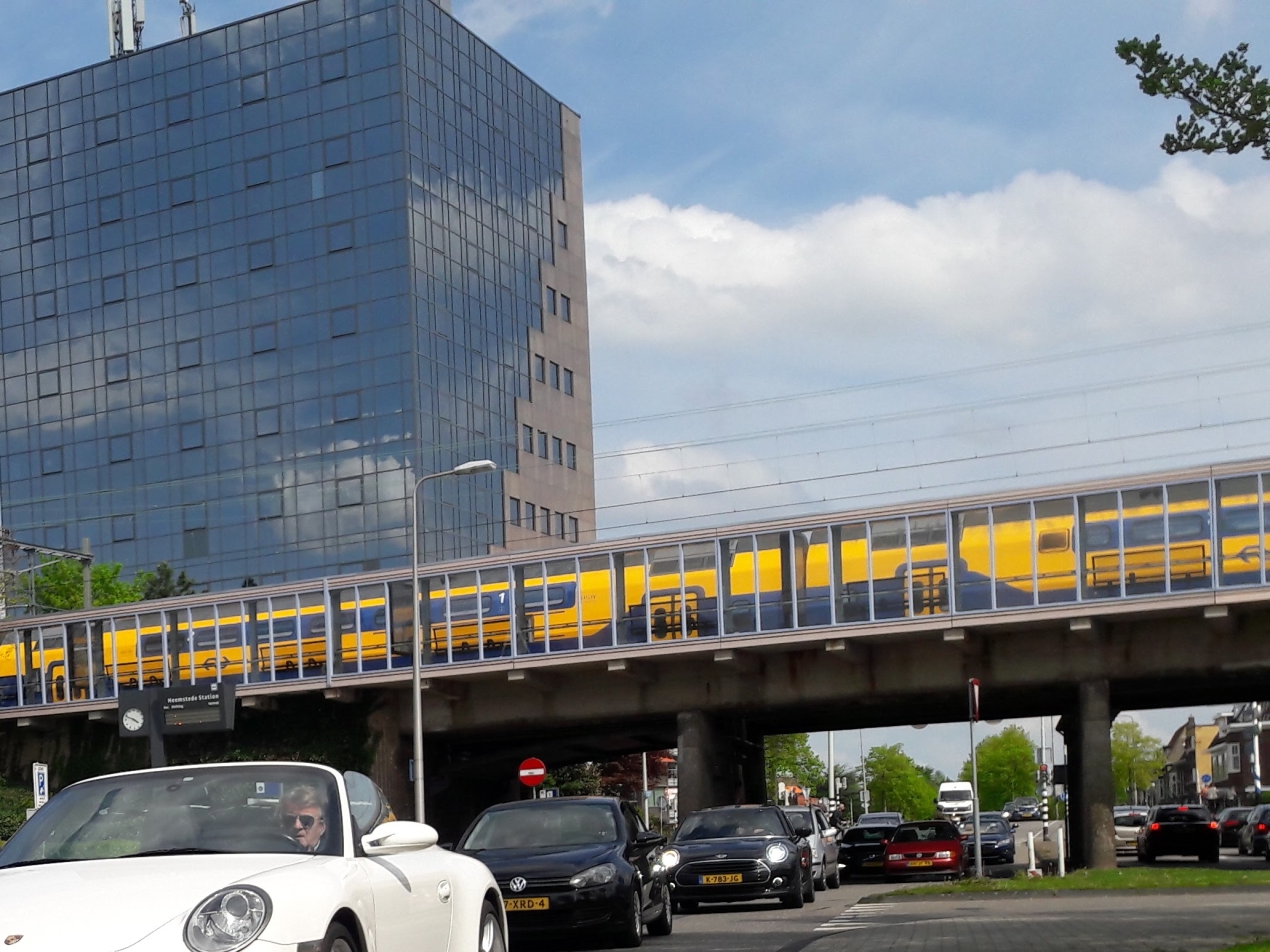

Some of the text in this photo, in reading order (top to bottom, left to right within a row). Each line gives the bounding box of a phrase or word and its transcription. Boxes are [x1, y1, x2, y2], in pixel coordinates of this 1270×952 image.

[498, 592, 506, 604] 1
[167, 694, 197, 704] Heemstede
[198, 693, 220, 701] Station
